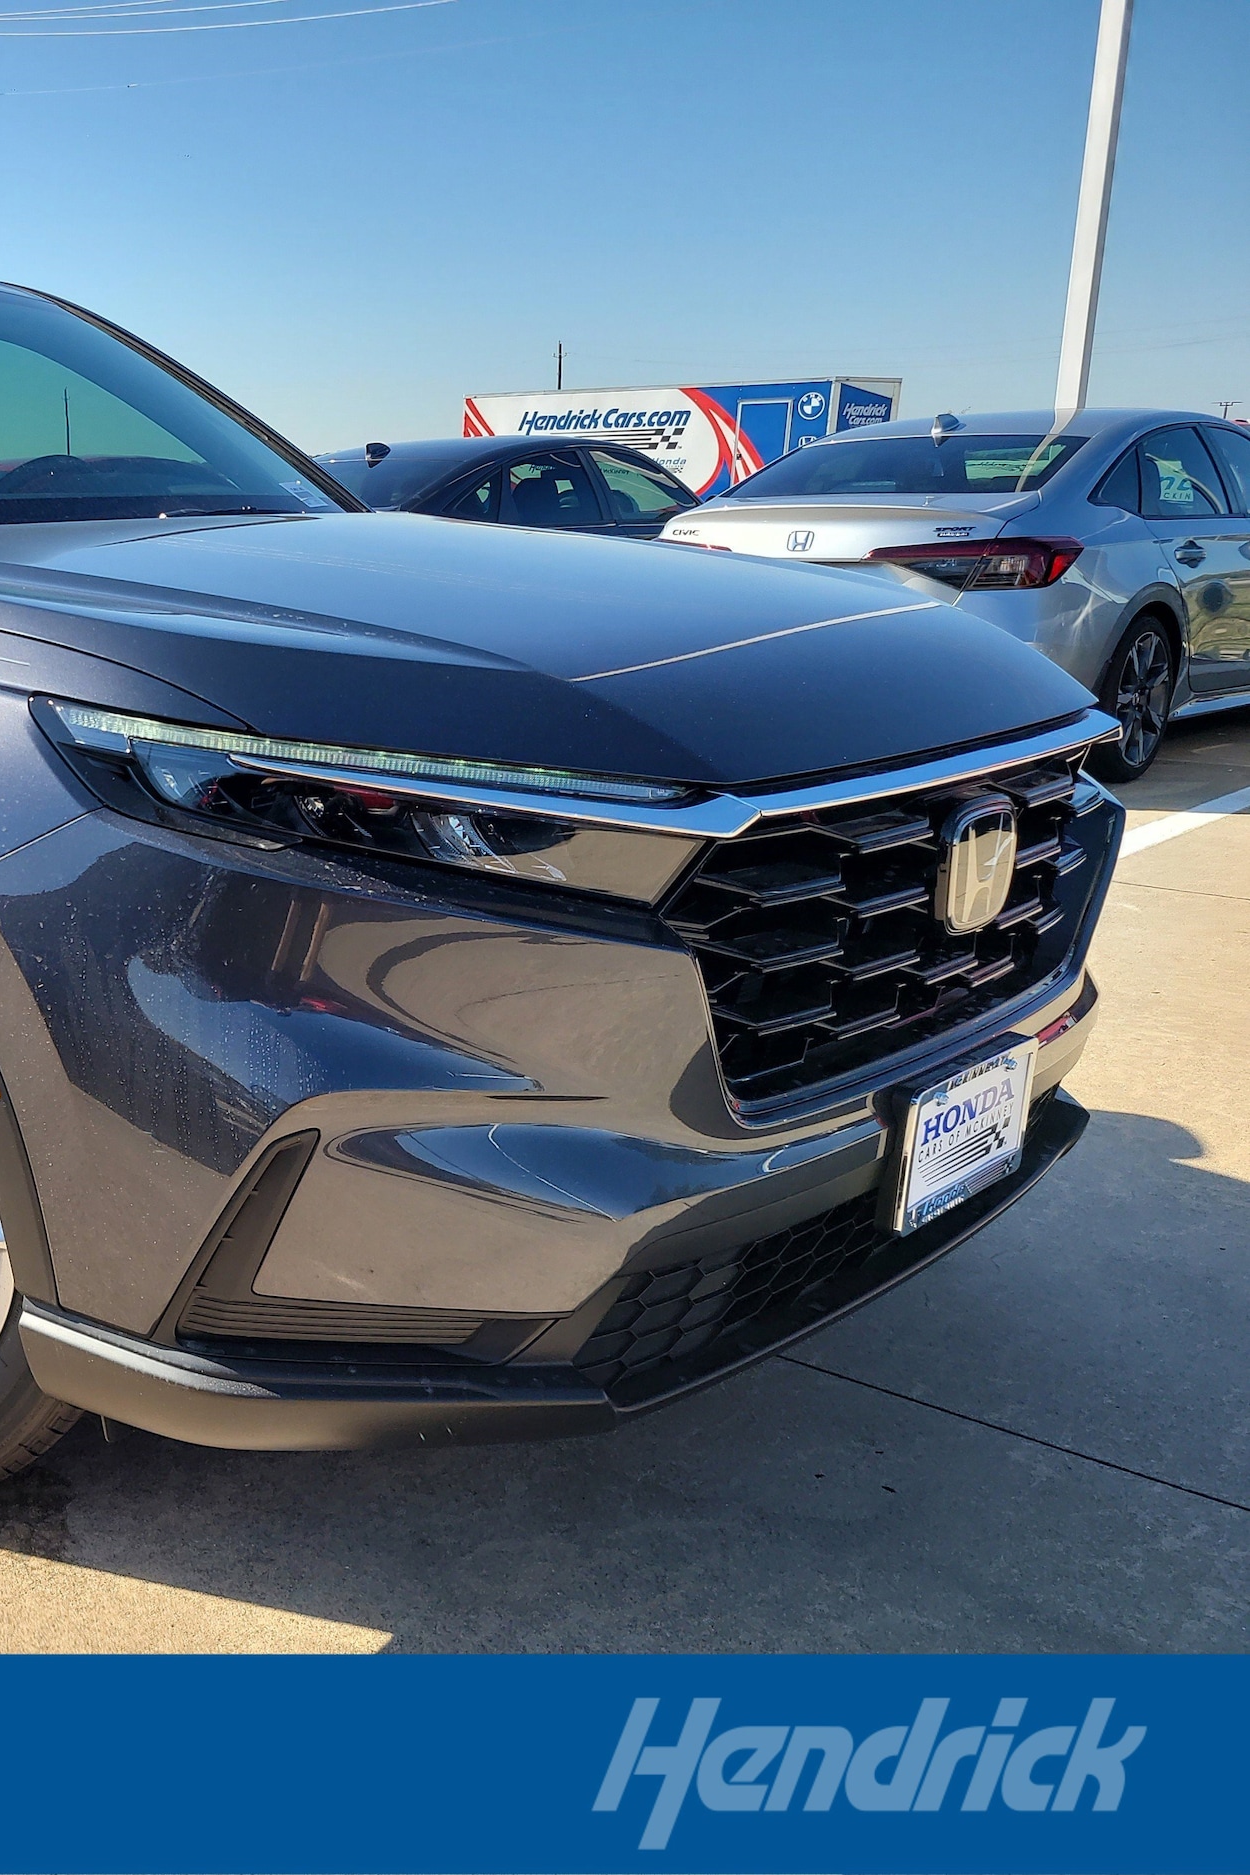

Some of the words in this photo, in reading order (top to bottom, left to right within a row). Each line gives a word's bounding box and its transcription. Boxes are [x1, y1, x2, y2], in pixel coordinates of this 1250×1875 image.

[842, 403, 888, 419] Hendrick
[918, 1140, 943, 1164] CARS
[948, 1130, 960, 1146] OF
[966, 1101, 1015, 1136] MCKINNEY
[921, 1078, 1015, 1147] HONDA
